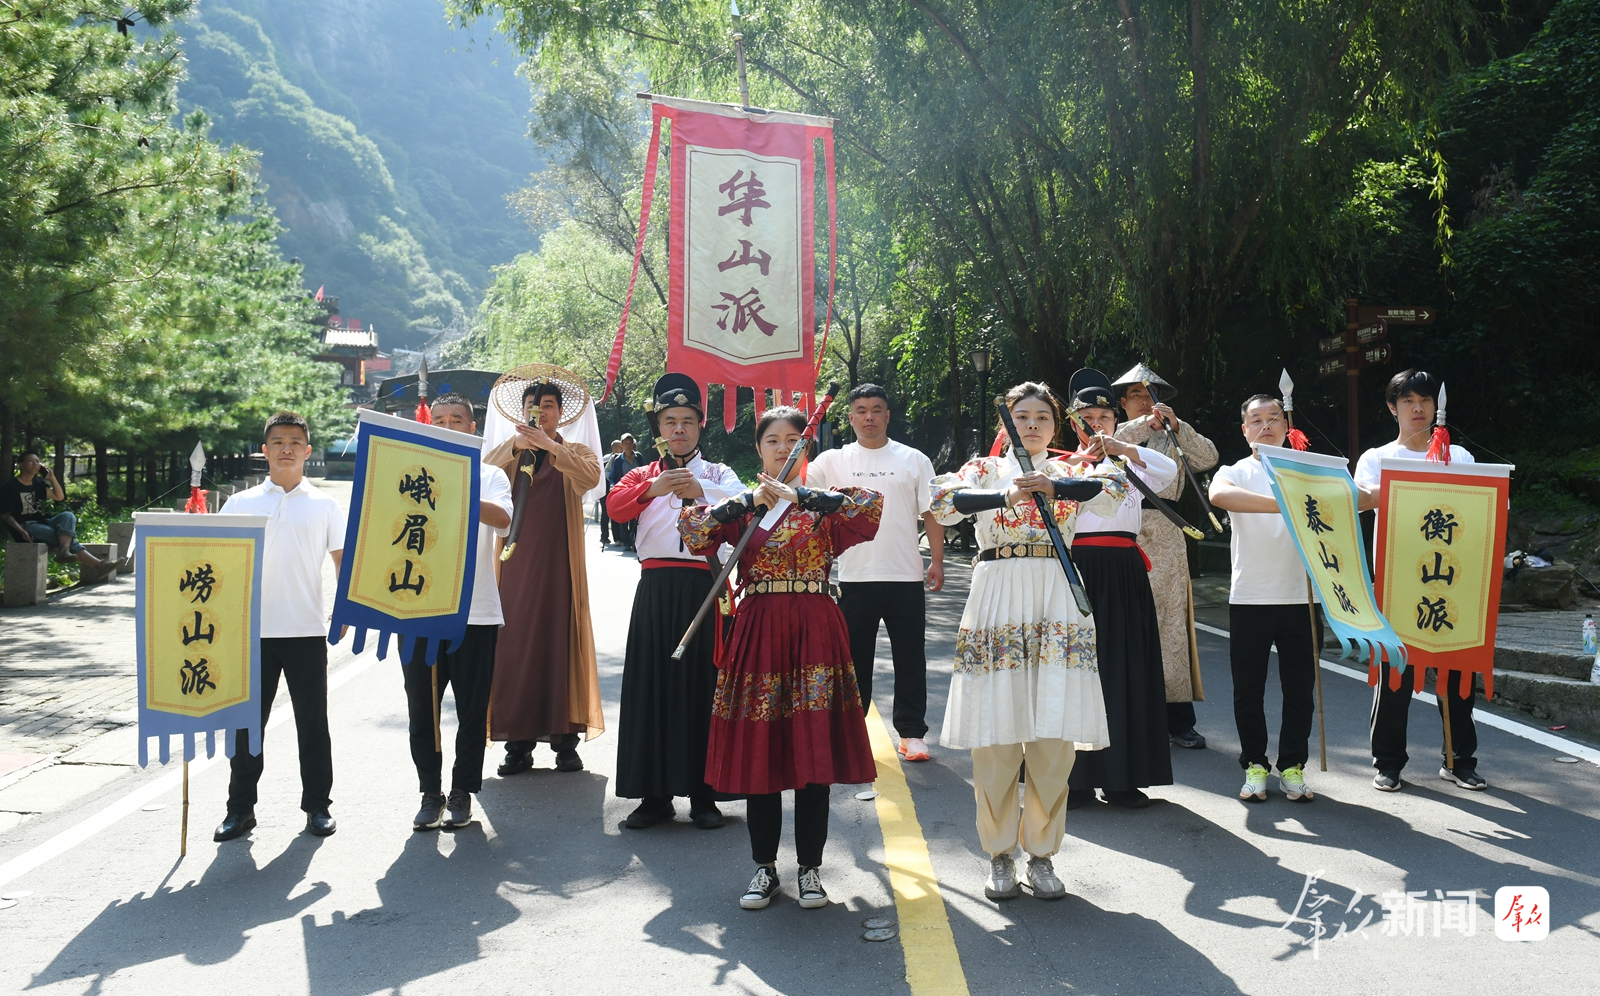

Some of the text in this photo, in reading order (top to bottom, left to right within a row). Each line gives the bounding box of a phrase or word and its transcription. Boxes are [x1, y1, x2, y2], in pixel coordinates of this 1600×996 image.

[710, 169, 779, 337] 华山派
[389, 467, 436, 596] 峨眉山
[1304, 494, 1359, 614] 泰山派
[1417, 508, 1458, 632] 衡山派
[179, 563, 217, 695] 崂山派
